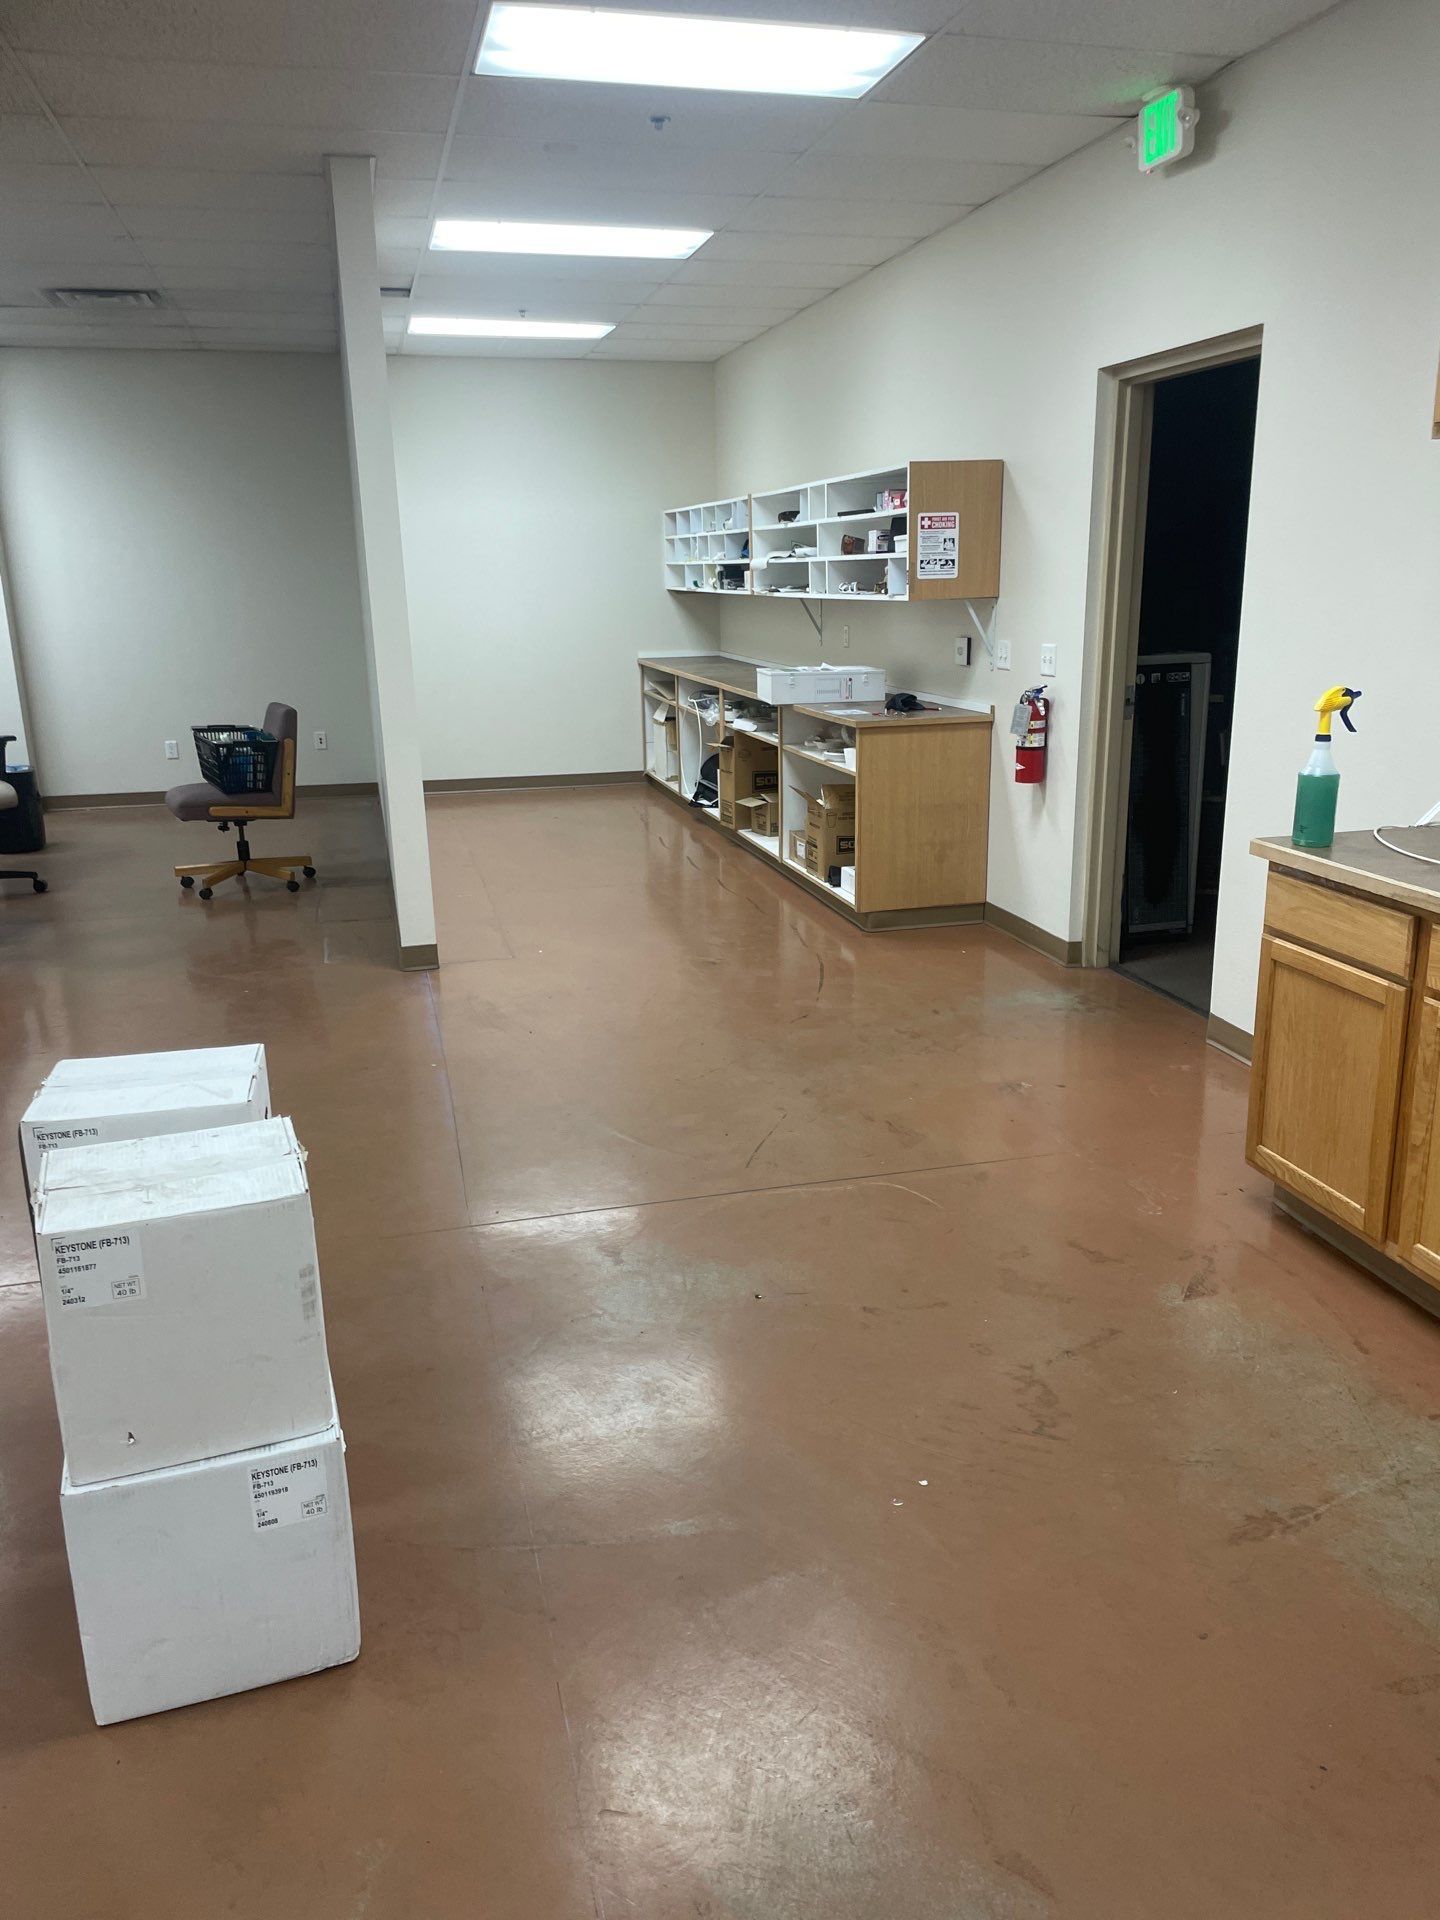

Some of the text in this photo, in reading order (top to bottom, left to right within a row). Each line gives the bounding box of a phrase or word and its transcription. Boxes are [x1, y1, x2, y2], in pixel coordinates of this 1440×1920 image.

[36, 1128, 98, 1141] KEYSTONE (FB-713)
[55, 1236, 130, 1254] KEYSTONE (FB-713)
[56, 1256, 80, 1264] FB-713
[62, 1296, 86, 1306] 240312
[251, 1459, 318, 1480] KEYSTONE (FB-713)
[252, 1481, 274, 1490] FB-713
